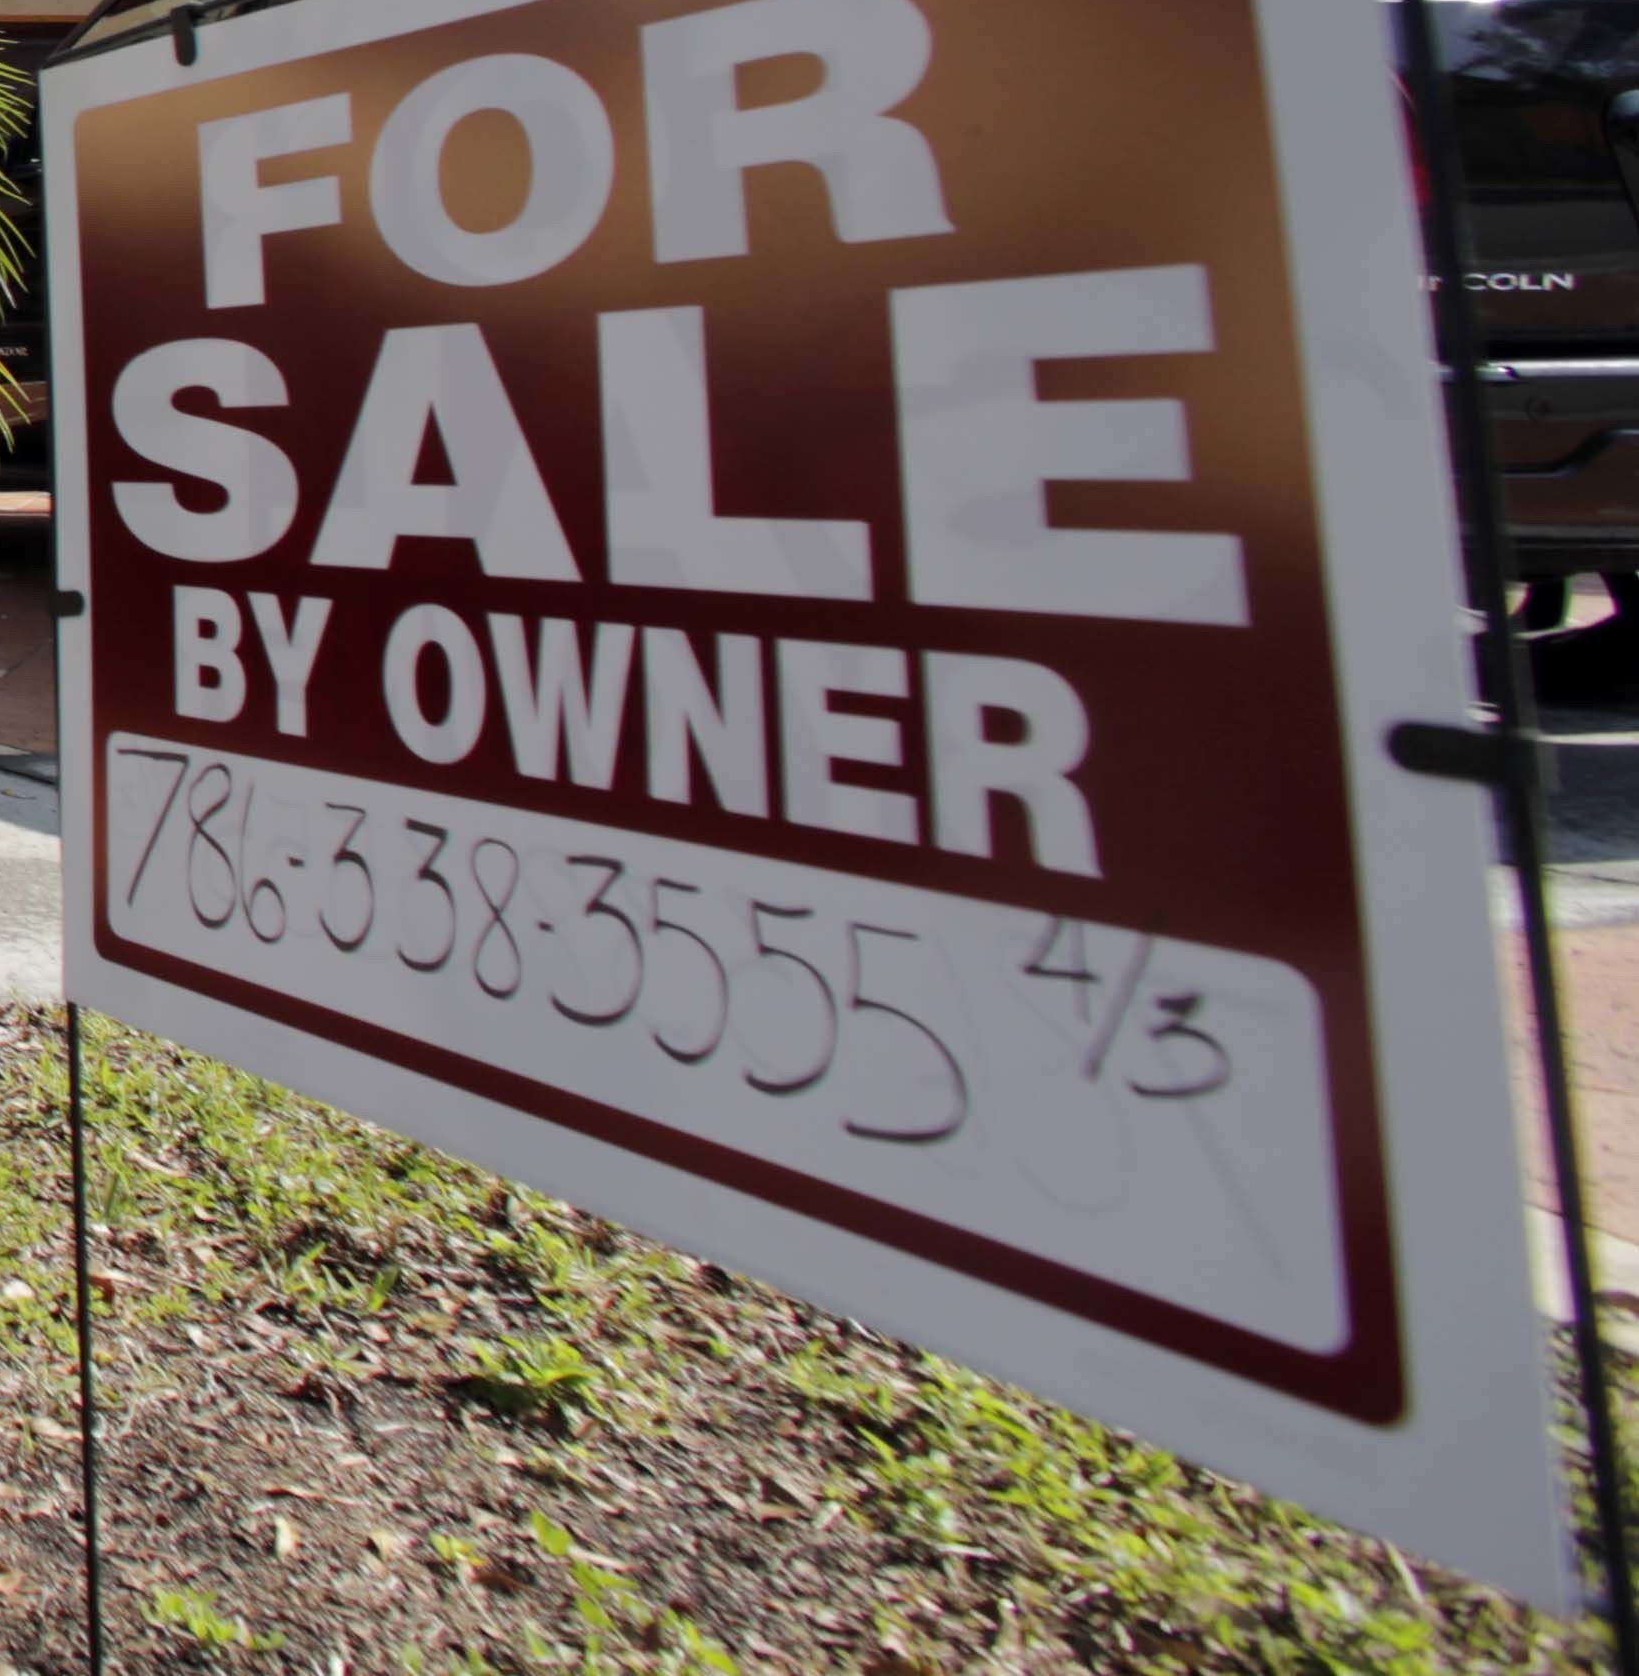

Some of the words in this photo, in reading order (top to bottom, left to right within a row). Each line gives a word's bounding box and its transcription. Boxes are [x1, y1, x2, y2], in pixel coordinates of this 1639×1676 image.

[109, 264, 1251, 629] SALE
[173, 586, 334, 738] BY
[383, 602, 1103, 879] OWNER
